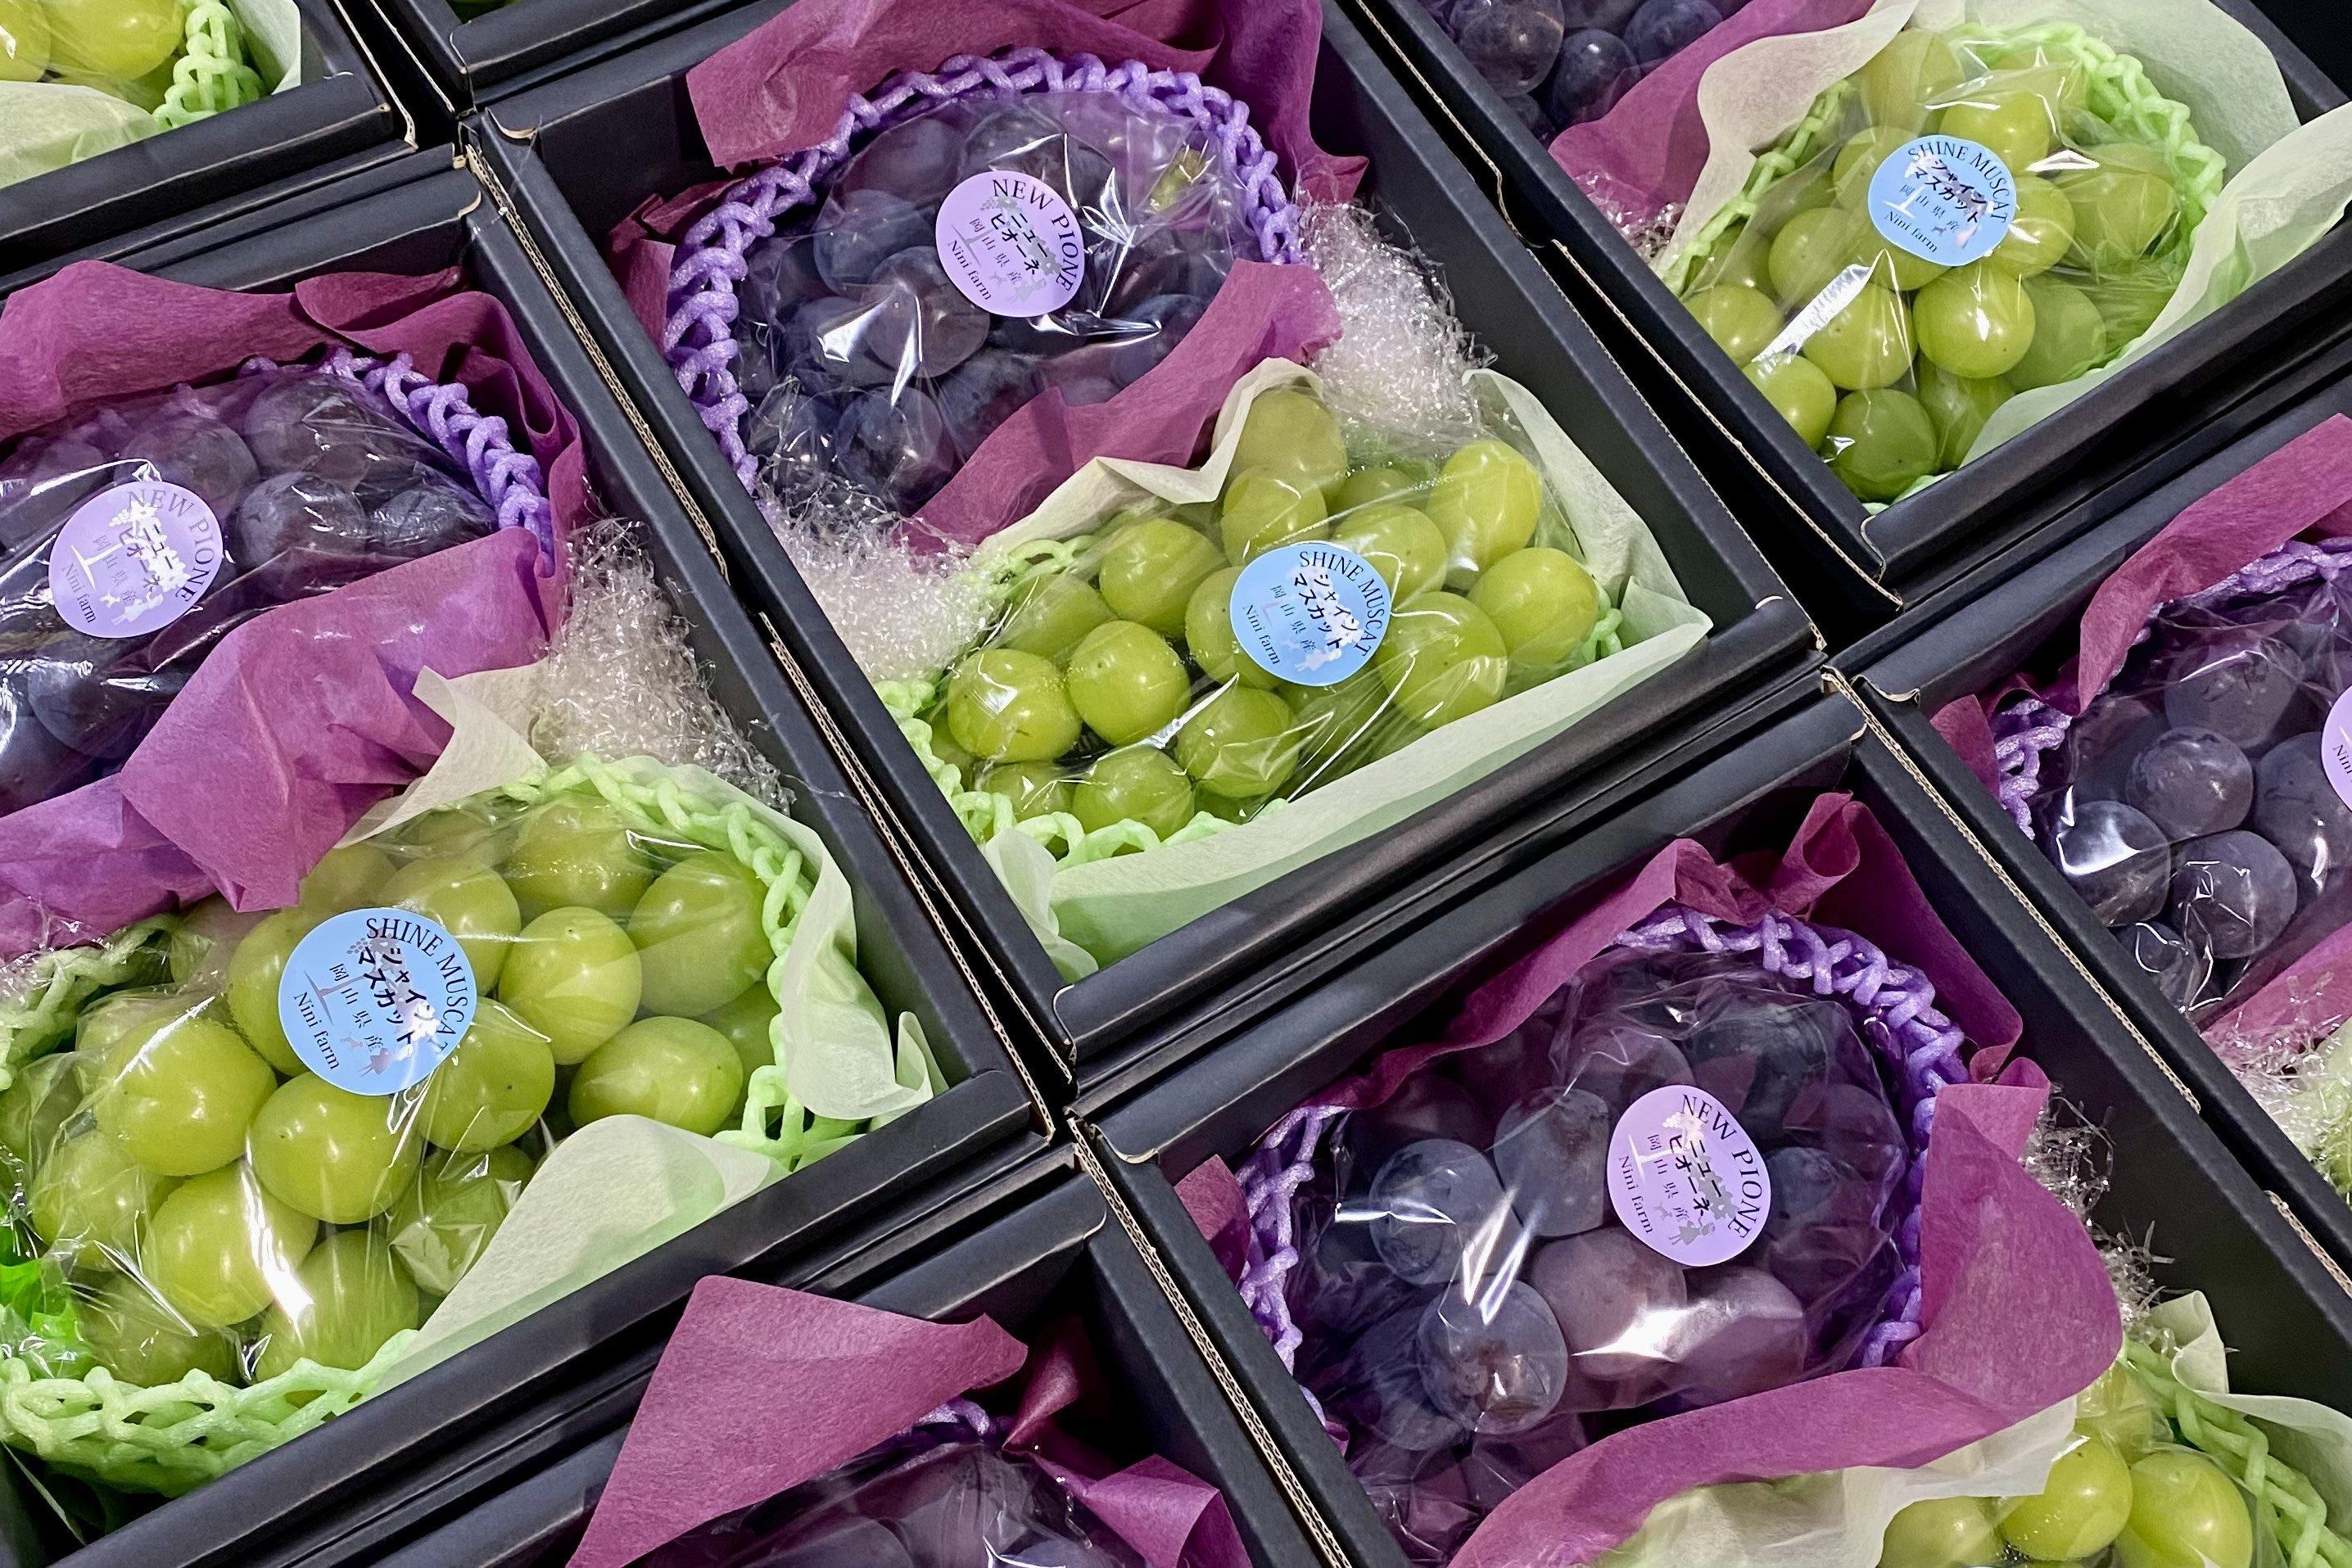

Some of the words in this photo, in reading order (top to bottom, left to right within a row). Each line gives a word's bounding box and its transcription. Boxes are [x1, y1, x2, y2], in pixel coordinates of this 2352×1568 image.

[1908, 141, 1969, 162] SHINE
[1970, 152, 2010, 224] MUSCAT
[1916, 167, 1979, 224] マスカット
[1931, 159, 1987, 205] シャイン
[948, 240, 972, 269] Nini
[968, 269, 992, 300] farm
[991, 213, 1039, 275] ピオーネ
[992, 178, 1054, 210] NEW
[1051, 213, 1079, 291] PIONE
[1011, 213, 1048, 258] ニュー
[1911, 227, 1938, 253] farm
[128, 489, 196, 518] NEW
[174, 516, 215, 603] PIONE
[143, 523, 174, 570] ニュー
[62, 563, 85, 599] Nini
[77, 593, 97, 624] farm
[1294, 573, 1343, 649] マスカット
[1299, 551, 1364, 582] SHINE
[1353, 578, 1385, 657] MUSCAT
[1314, 574, 1358, 630] シャイン
[1242, 604, 1265, 633] Nini
[1259, 634, 1281, 665] farm
[358, 947, 416, 1045] マスカット
[366, 917, 443, 956] SHINE
[427, 953, 468, 1051] MUSCAT
[382, 947, 436, 1020] シャイン
[293, 992, 323, 1029] Nini
[314, 1030, 340, 1070] farm
[1618, 1155, 1639, 1191] Nini
[1631, 1195, 1654, 1235] farm
[1669, 1134, 1711, 1217] ピオーネ
[1680, 1094, 1738, 1141] NEW
[1727, 1148, 1762, 1239] PIONE
[1689, 1140, 1722, 1198] ニュー
